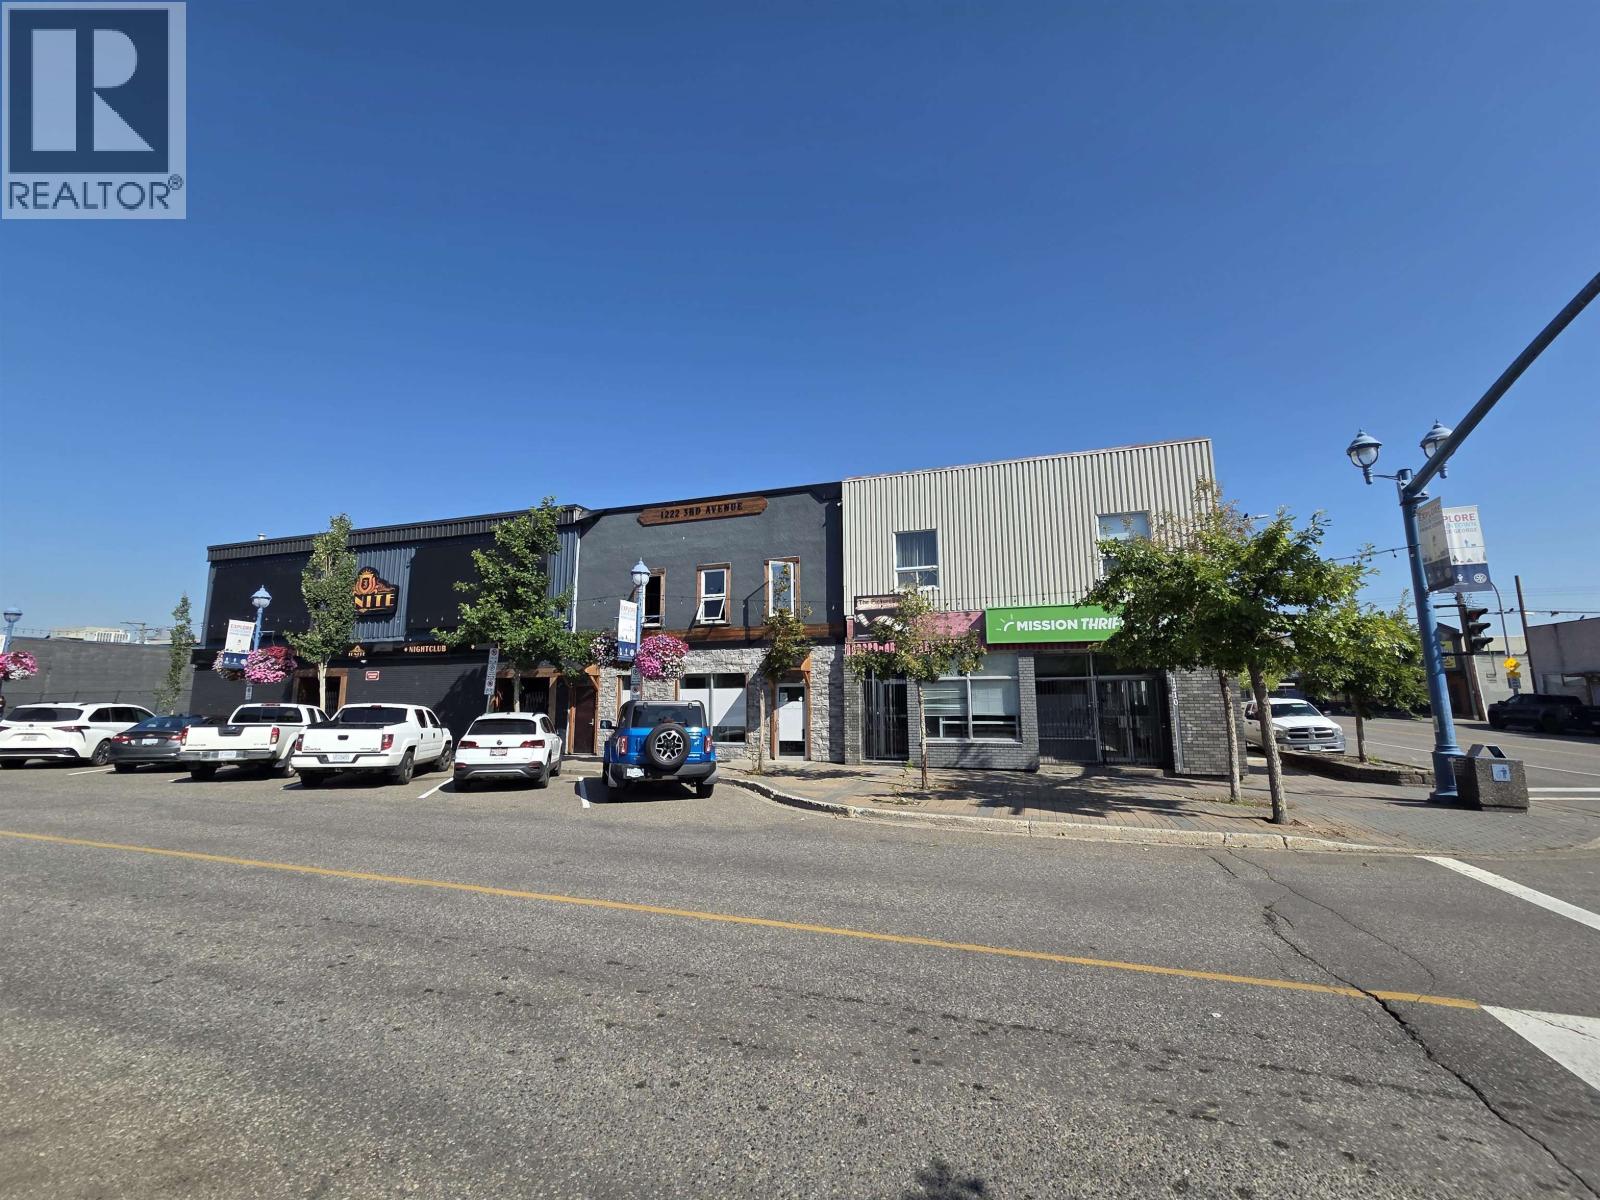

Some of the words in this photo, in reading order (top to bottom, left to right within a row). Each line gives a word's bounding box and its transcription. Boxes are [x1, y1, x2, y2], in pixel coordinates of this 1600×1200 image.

[660, 509, 680, 519] 1222
[684, 506, 701, 517] 3RD
[706, 502, 743, 514] AVENUE
[1443, 513, 1476, 522] PLORE
[354, 593, 395, 608] NITE
[1016, 619, 1078, 631] MISSION
[1081, 617, 1123, 630] THRIF
[408, 645, 447, 653] NIGHTCLUB
